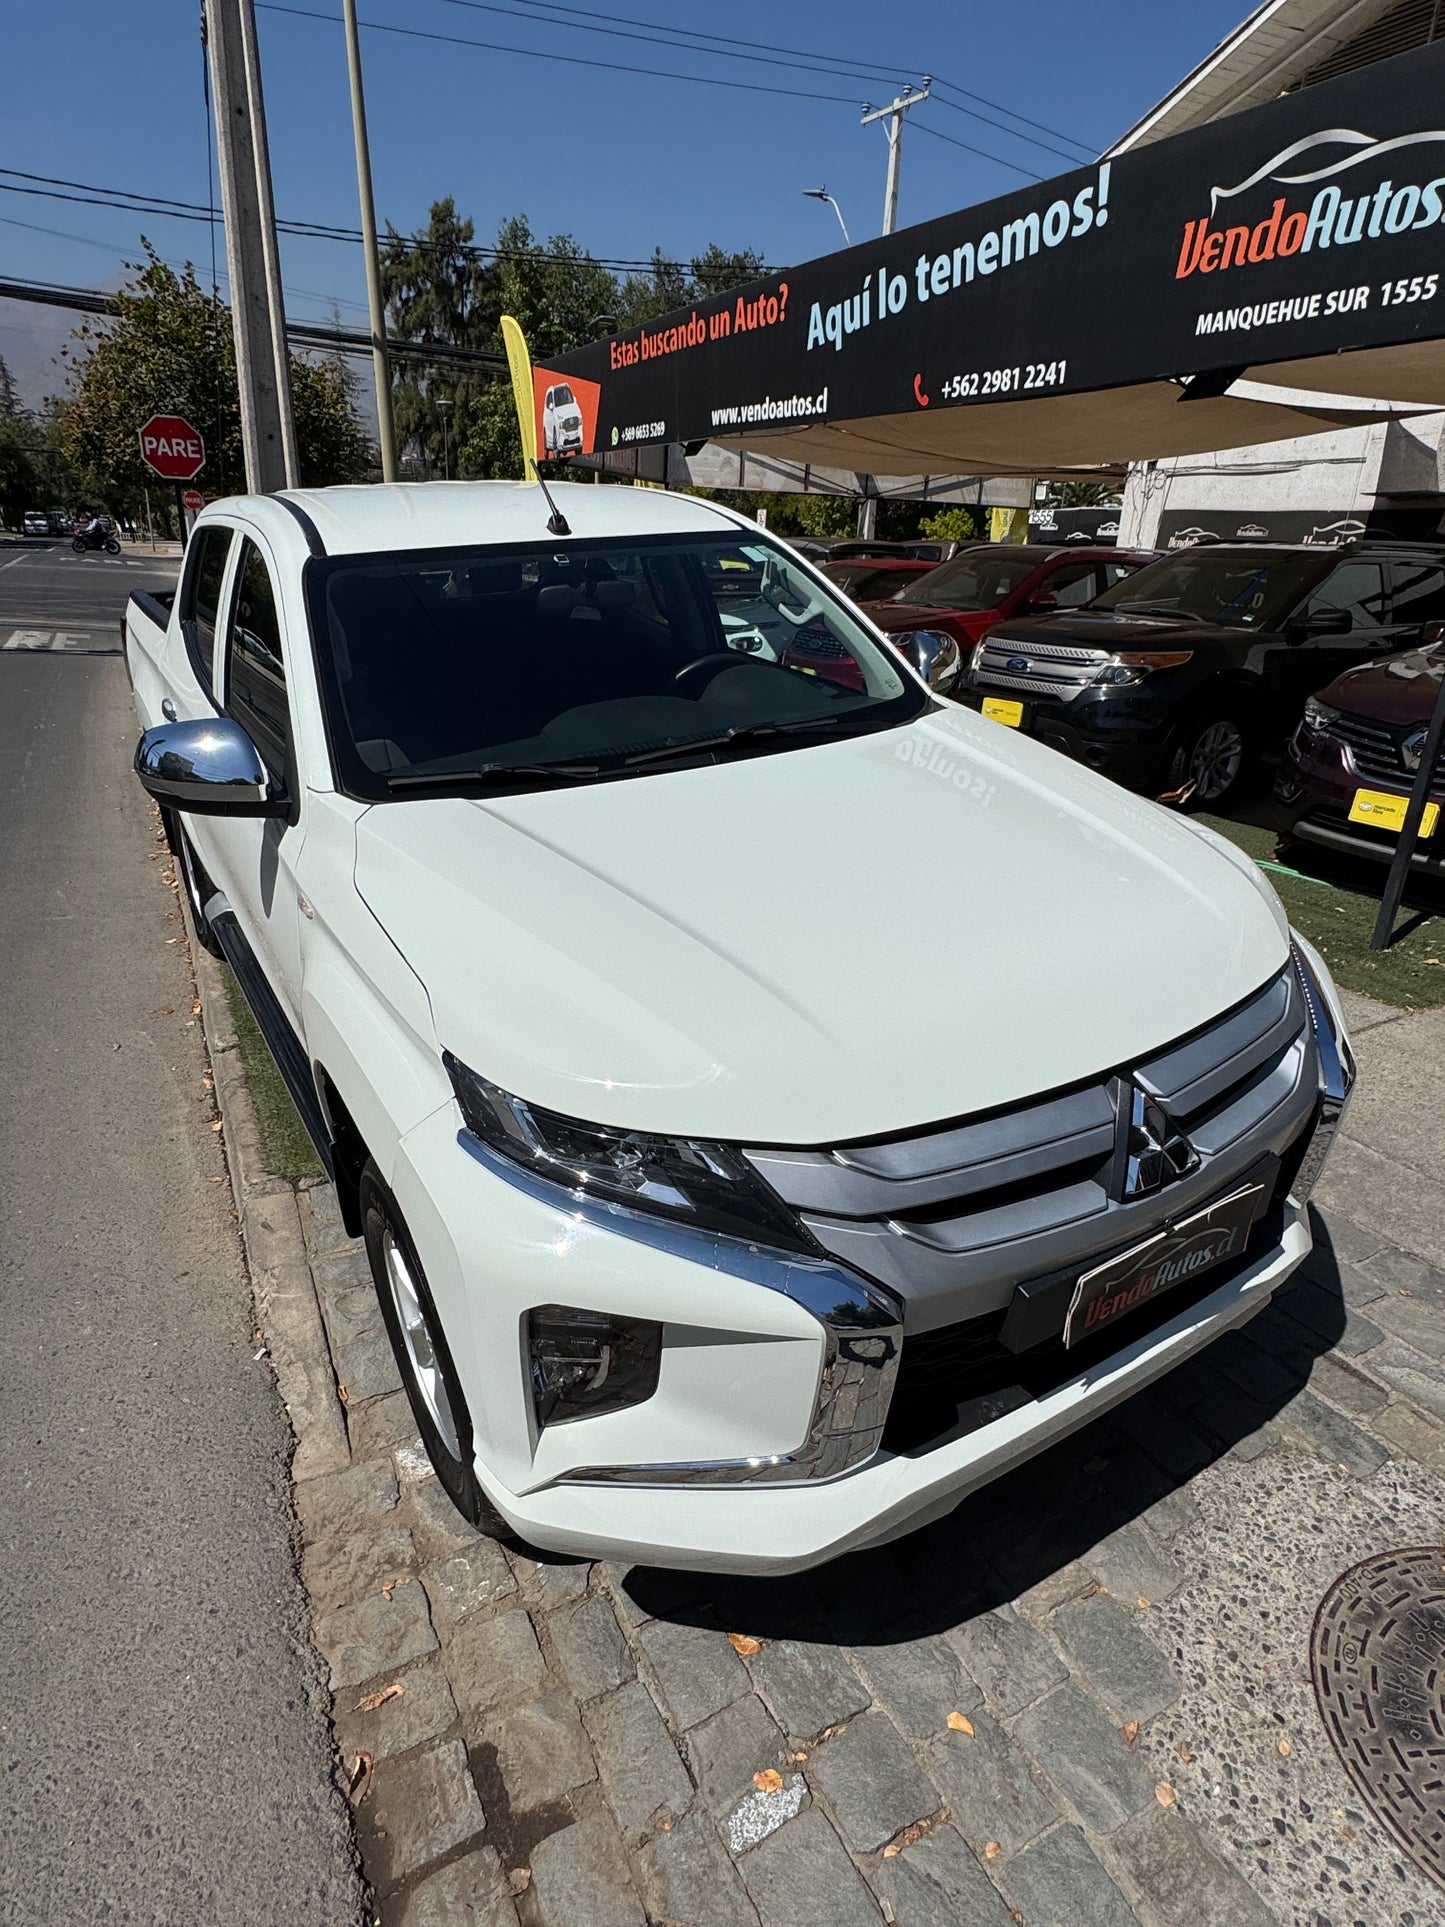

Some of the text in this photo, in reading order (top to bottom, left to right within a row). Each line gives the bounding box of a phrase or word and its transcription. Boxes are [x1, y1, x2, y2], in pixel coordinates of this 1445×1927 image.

[807, 161, 1112, 351] Aquí lo tenemos!
[610, 281, 789, 371] Estas buscando un Auto?
[1195, 274, 1440, 336] MANQUEHUE SUR 1555
[942, 359, 1067, 399] +562 2981 2241
[621, 420, 666, 442] +569 6653 5269
[711, 386, 828, 427] www.vendoautos.cl
[144, 436, 201, 458] PARE
[1084, 1226, 1238, 1329] VendoAutos.cl
